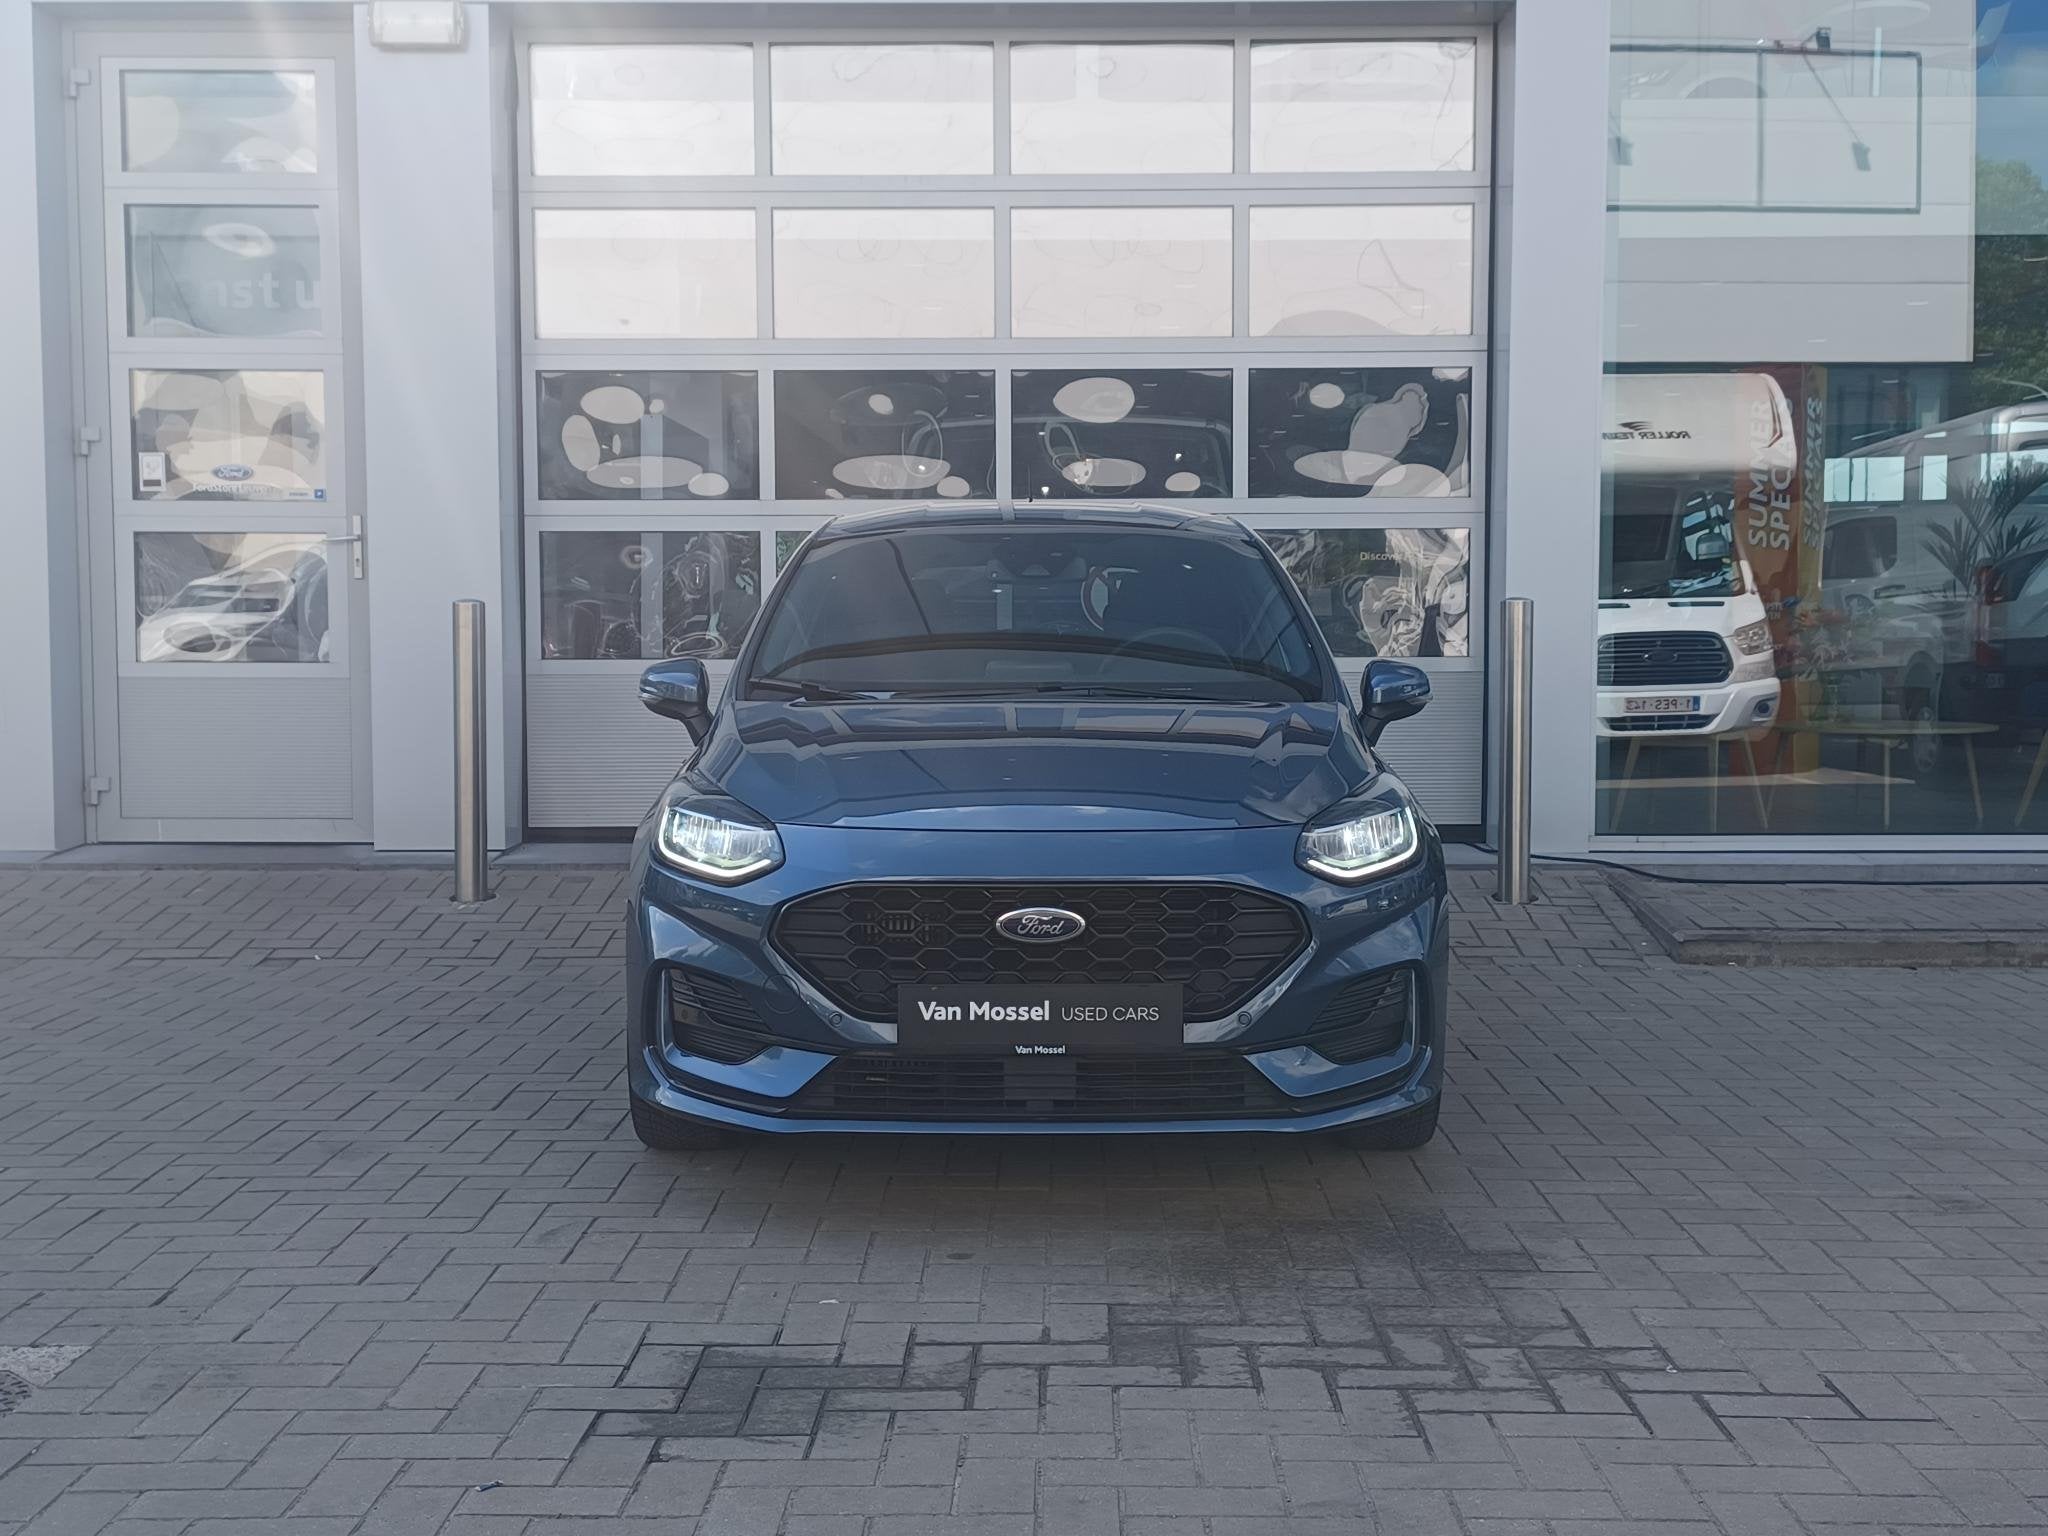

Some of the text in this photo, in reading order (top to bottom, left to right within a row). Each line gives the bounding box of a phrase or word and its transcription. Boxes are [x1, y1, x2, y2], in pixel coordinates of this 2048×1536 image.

[1748, 400, 1769, 548] SUMMER
[1017, 914, 1065, 936] Ford
[917, 1000, 1160, 1022] Van Mossel USED CARS
[1015, 1045, 1066, 1055] Van Mossel
